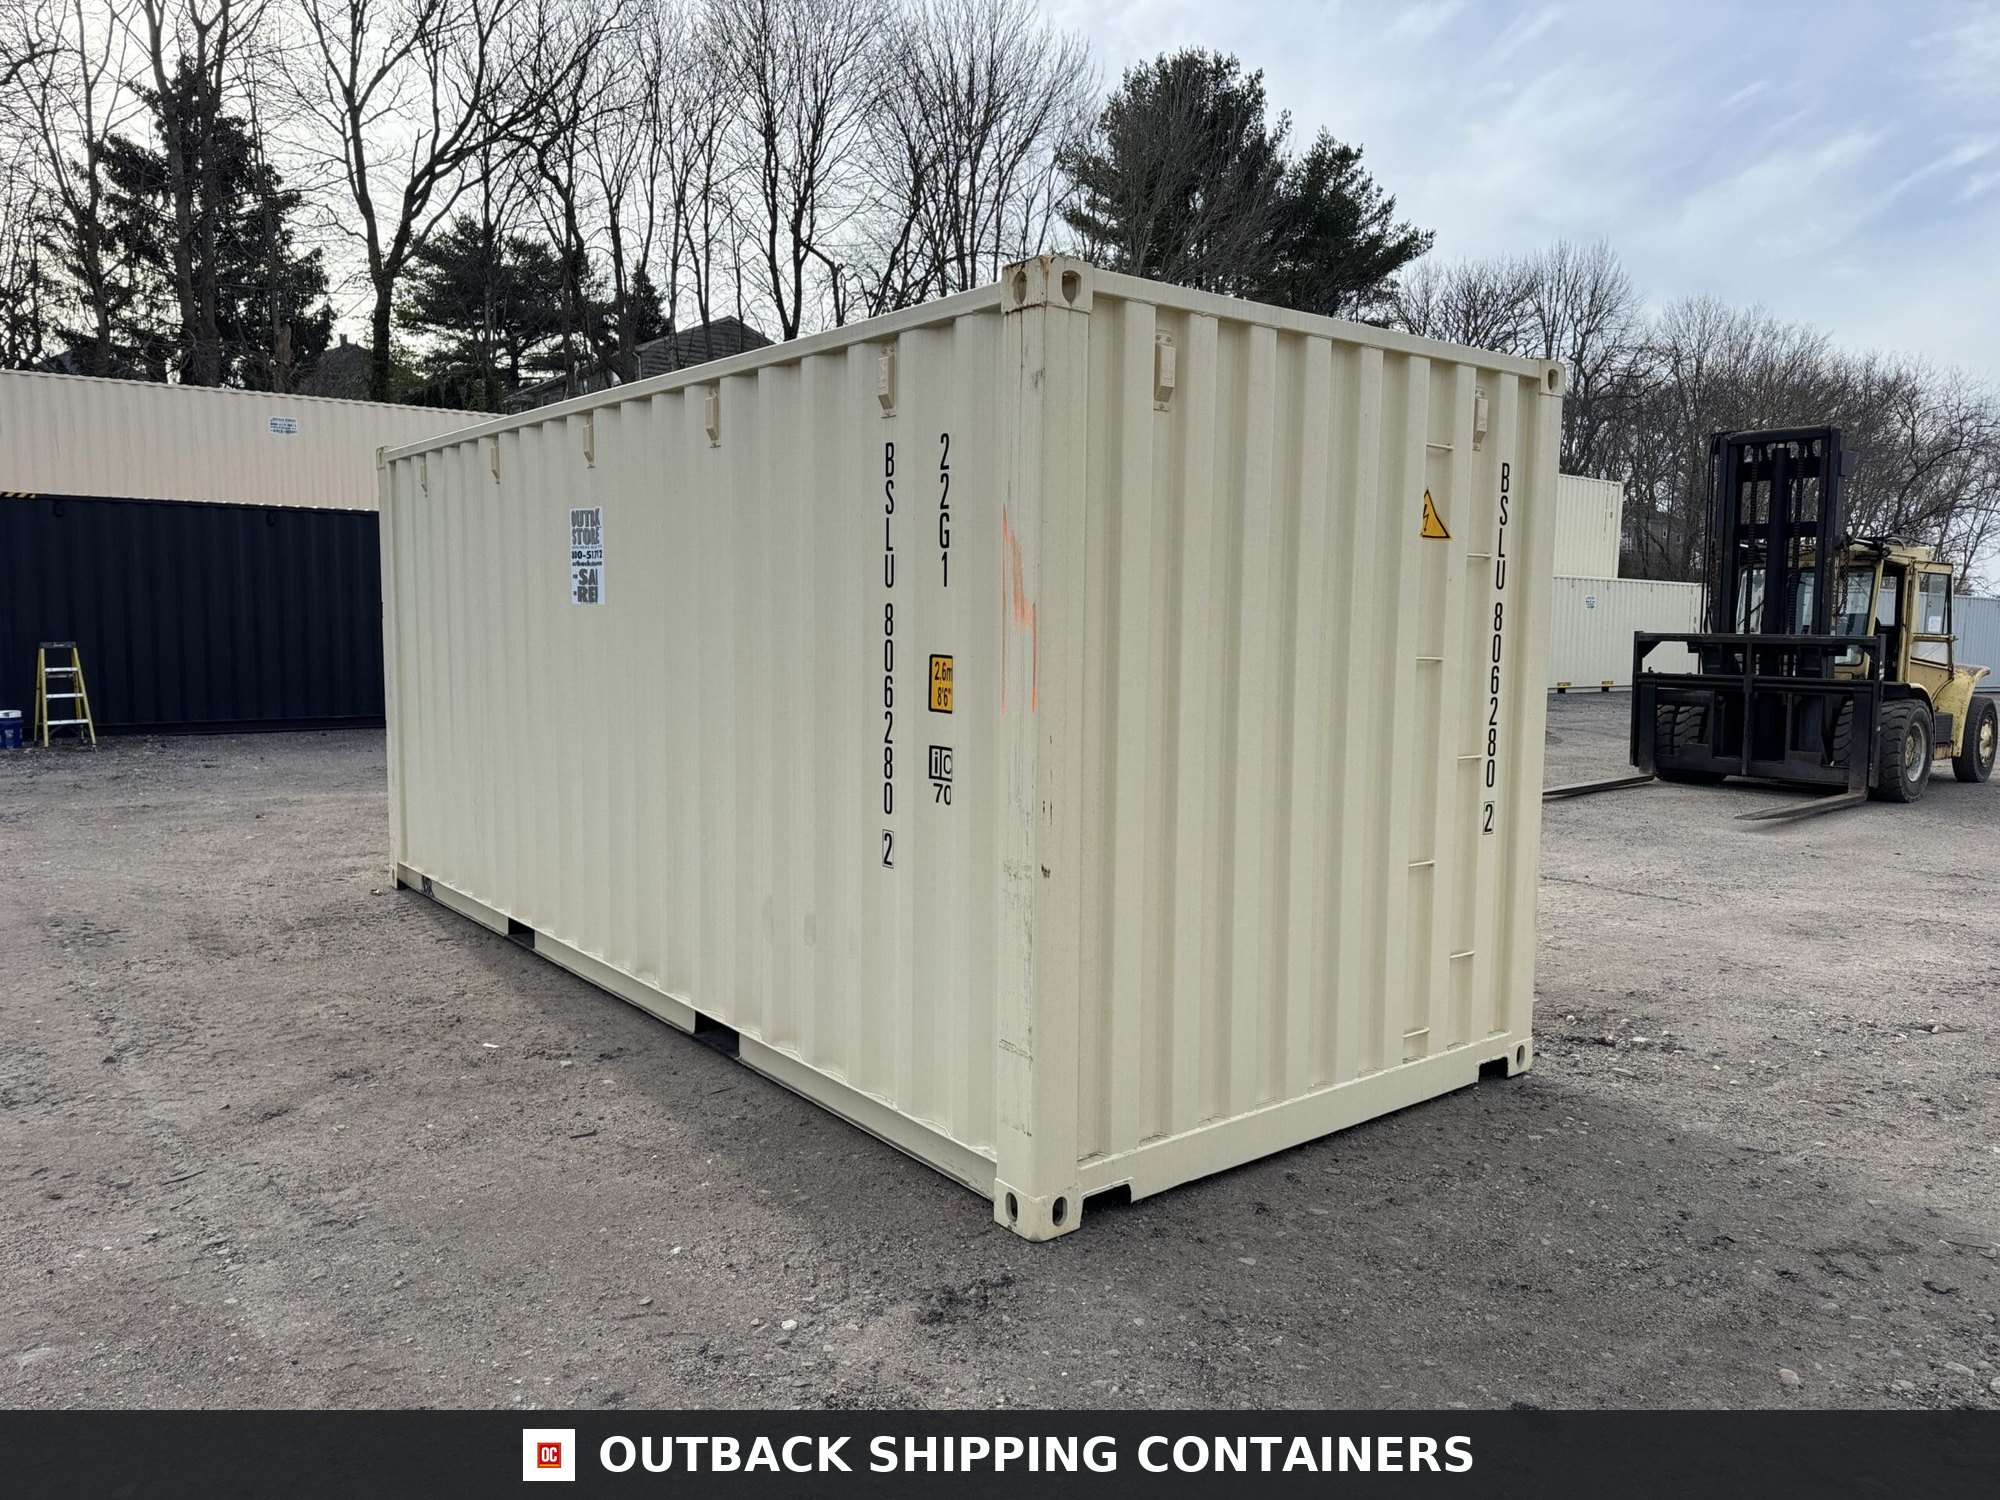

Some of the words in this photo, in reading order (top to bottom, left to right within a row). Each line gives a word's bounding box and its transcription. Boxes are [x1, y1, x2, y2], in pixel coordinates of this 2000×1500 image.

[884, 441, 895, 589] BSLU
[939, 432, 950, 588] 22G1
[1495, 462, 1510, 590] BSLU
[883, 602, 894, 815] 806280
[1486, 602, 1503, 788] 806280
[883, 831, 893, 867] 2
[933, 782, 952, 806] 70
[1484, 802, 1493, 833] 2
